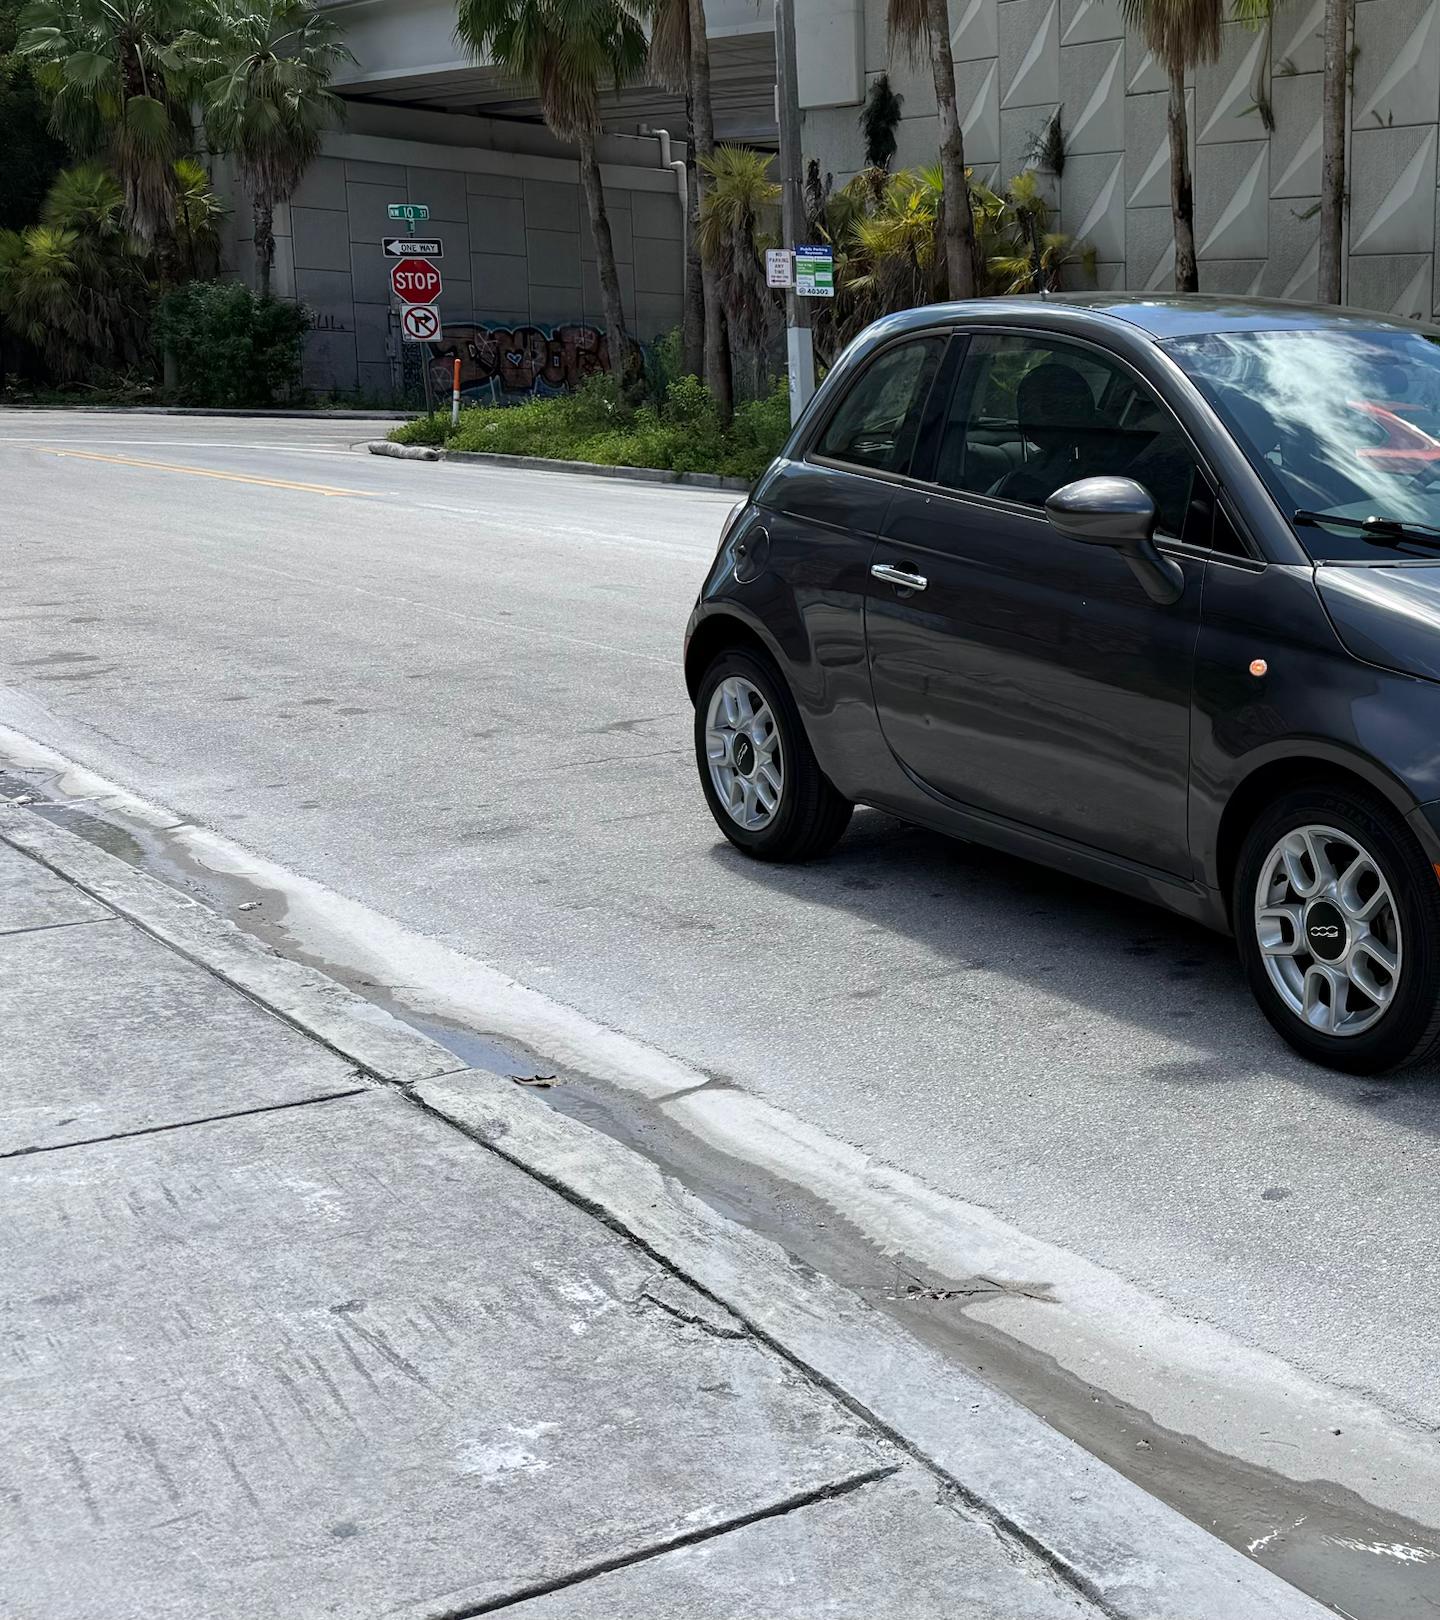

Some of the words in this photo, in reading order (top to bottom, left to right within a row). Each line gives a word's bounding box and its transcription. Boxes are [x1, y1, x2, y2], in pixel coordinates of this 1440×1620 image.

[389, 208, 400, 217] NW
[403, 206, 414, 218] 10
[419, 209, 427, 218] ST
[401, 244, 417, 252] ONE
[419, 244, 436, 252] WAY
[396, 272, 437, 289] STOP
